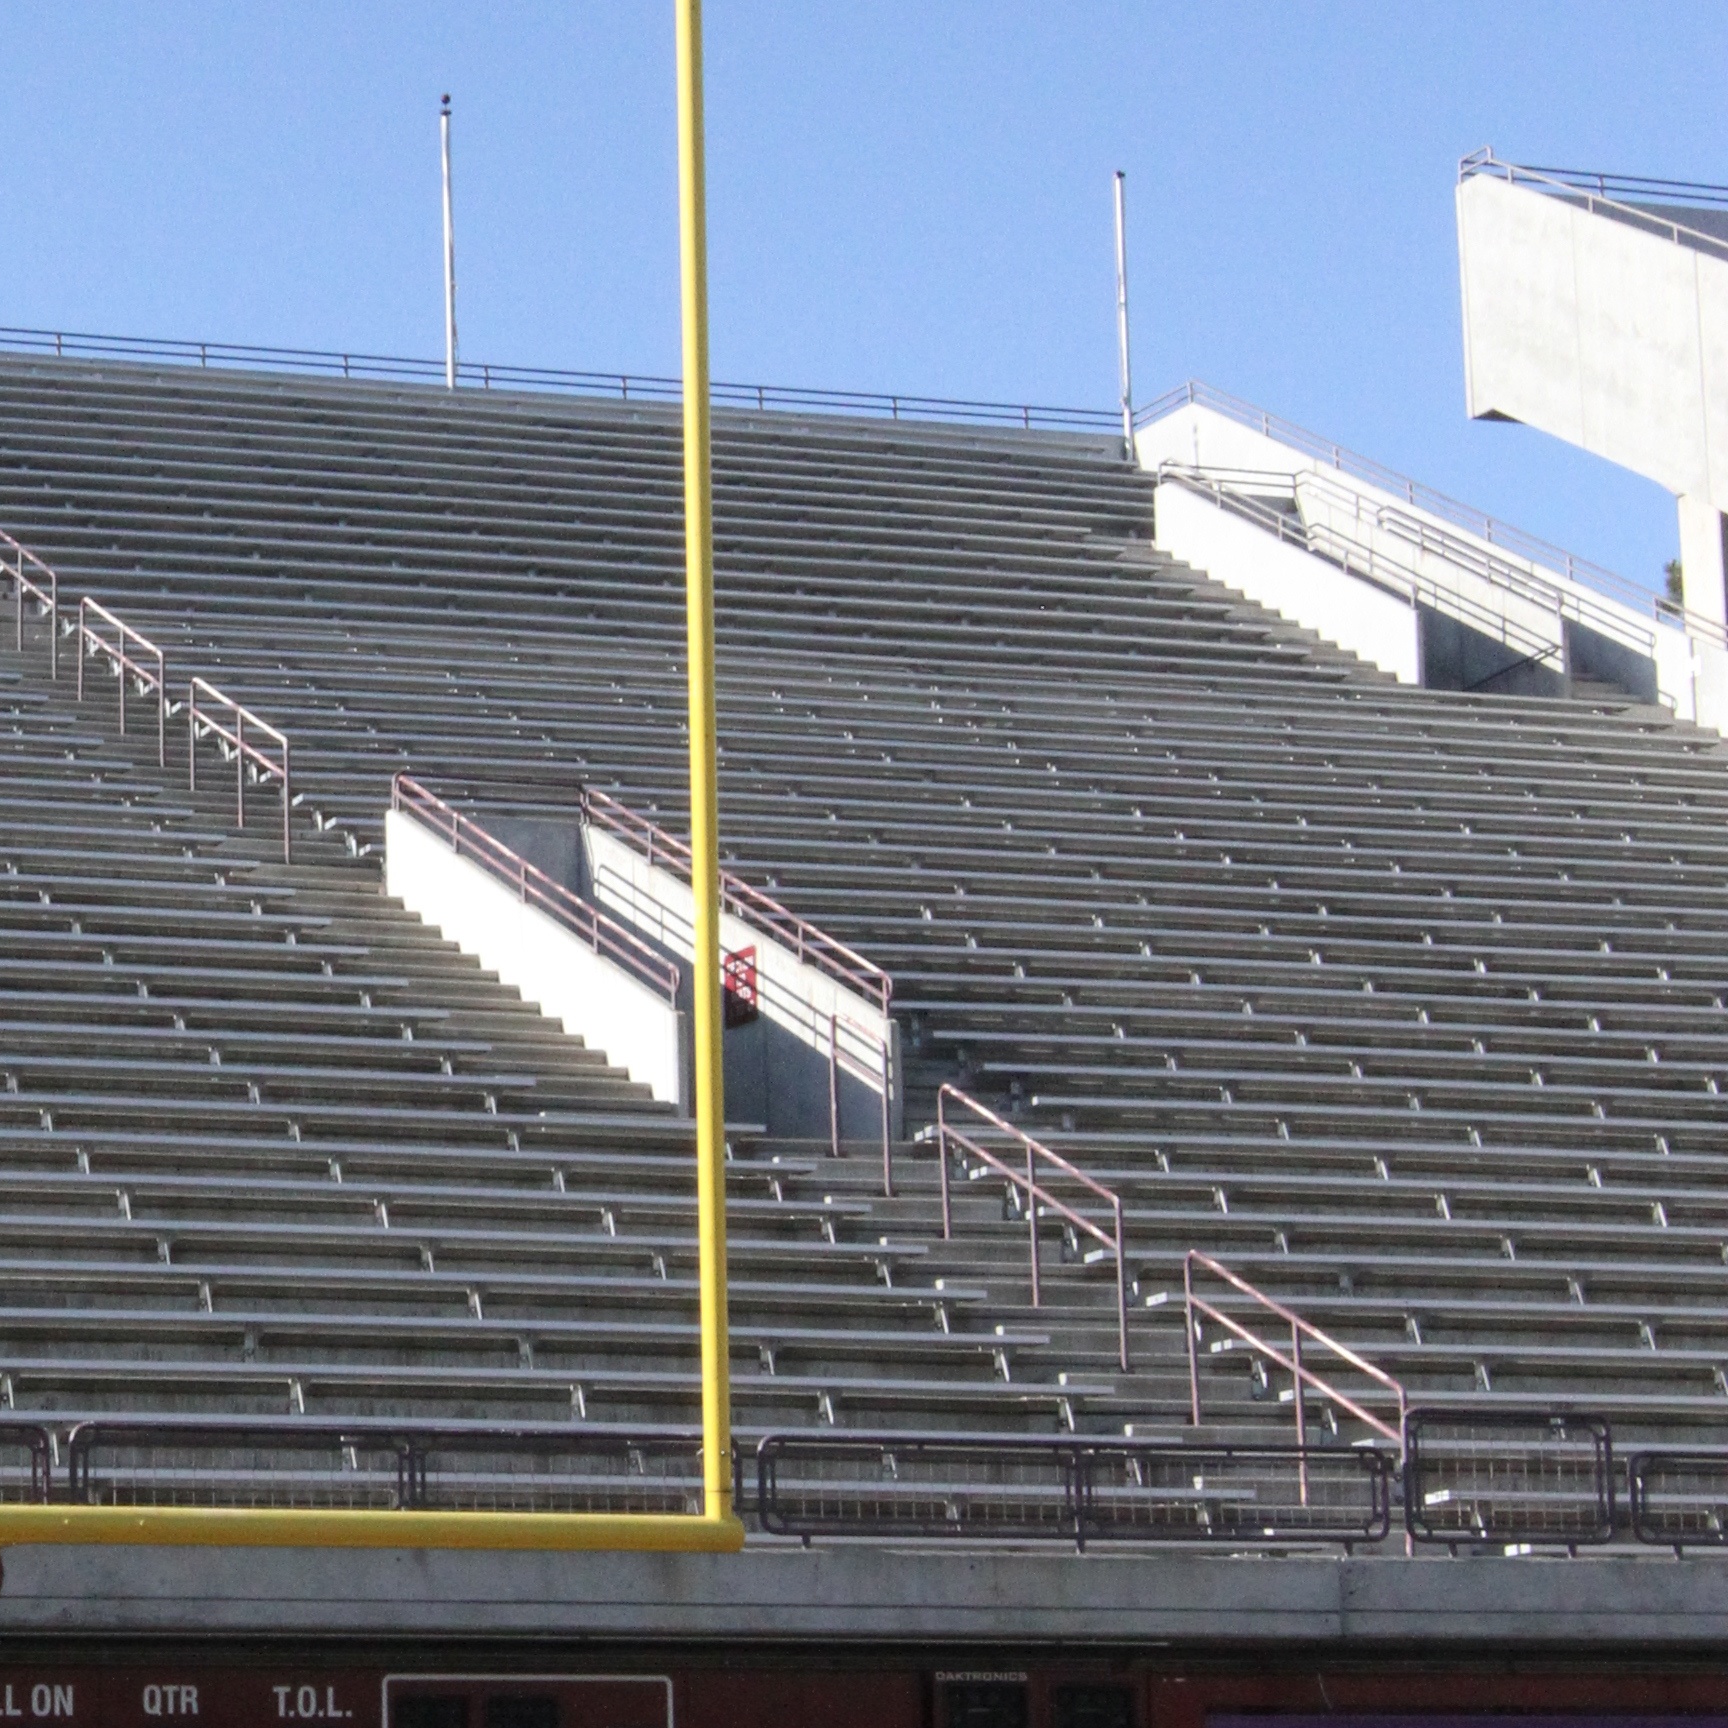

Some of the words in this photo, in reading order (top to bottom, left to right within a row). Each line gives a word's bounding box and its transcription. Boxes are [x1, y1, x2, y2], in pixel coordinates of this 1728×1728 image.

[31, 1684, 74, 1717] ON
[142, 1684, 199, 1718] QTR
[273, 1685, 353, 1718] T.O.L.
